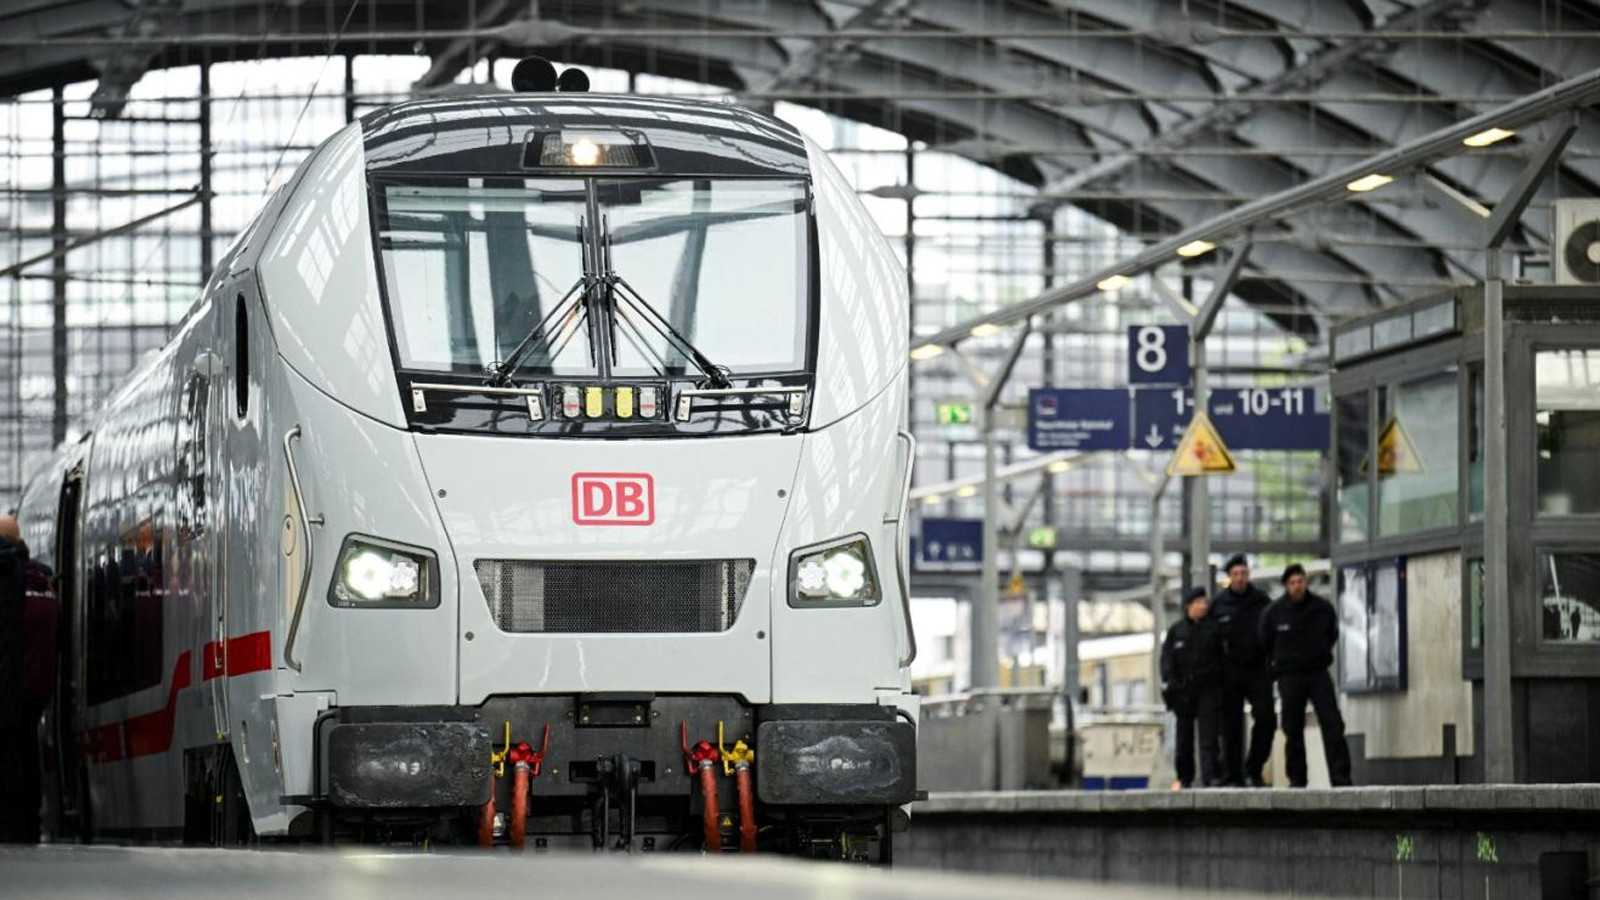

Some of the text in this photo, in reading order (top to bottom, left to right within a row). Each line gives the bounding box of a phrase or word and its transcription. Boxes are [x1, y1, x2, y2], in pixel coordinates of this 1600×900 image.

[1136, 326, 1167, 373] 8
[1238, 389, 1303, 416] 10-11
[583, 481, 644, 517] DB
